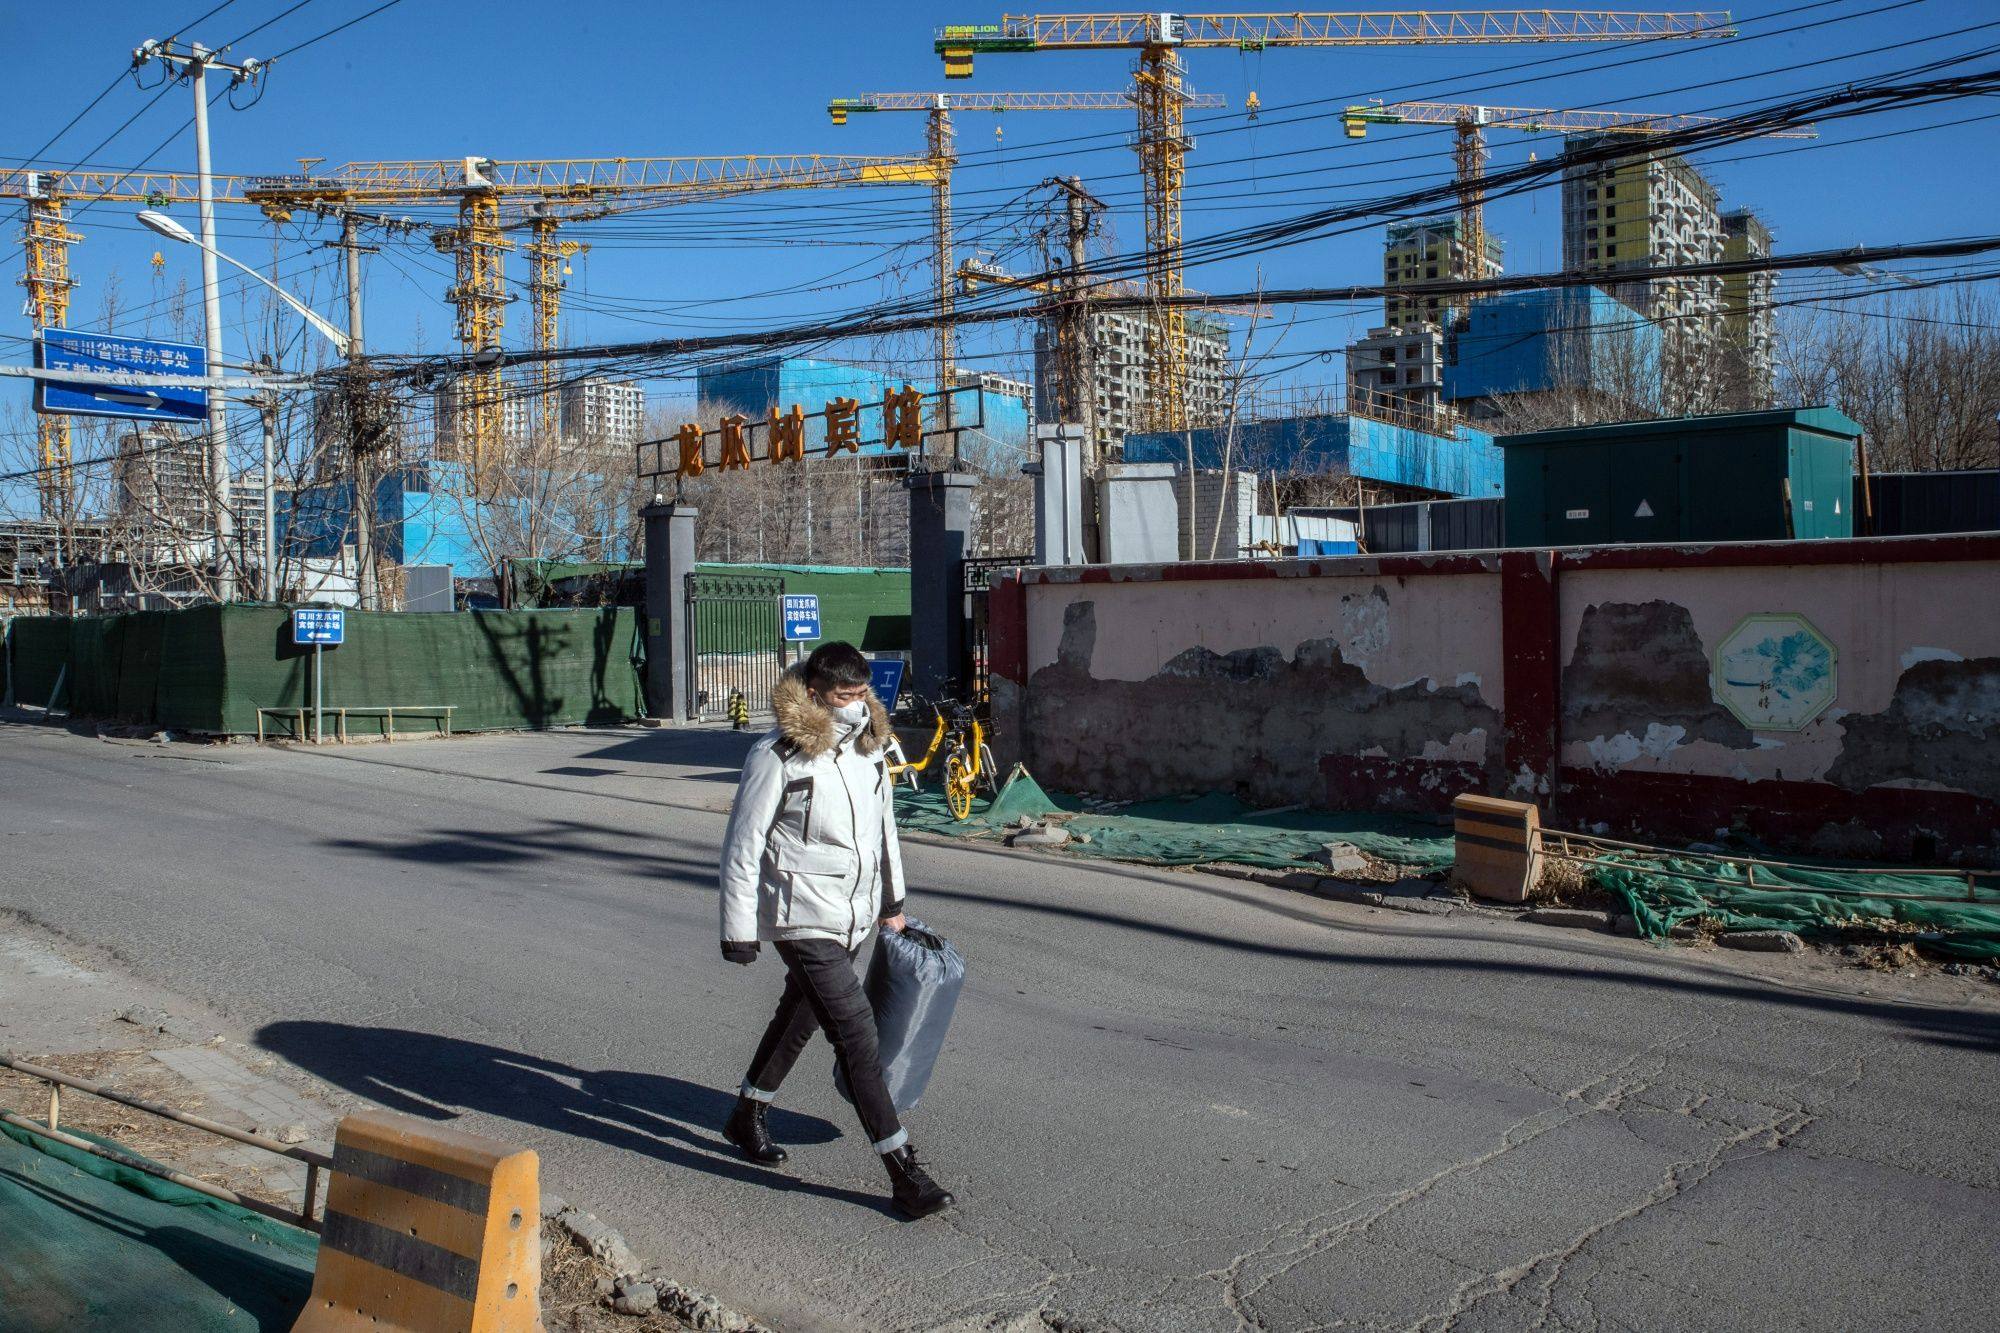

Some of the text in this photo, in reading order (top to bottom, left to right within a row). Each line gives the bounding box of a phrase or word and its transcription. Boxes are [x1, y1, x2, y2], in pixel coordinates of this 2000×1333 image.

[945, 25, 998, 33] ZOOMLION
[62, 338, 190, 369] 四川省驻京办事处
[673, 384, 923, 481] 龙爪树宾馆
